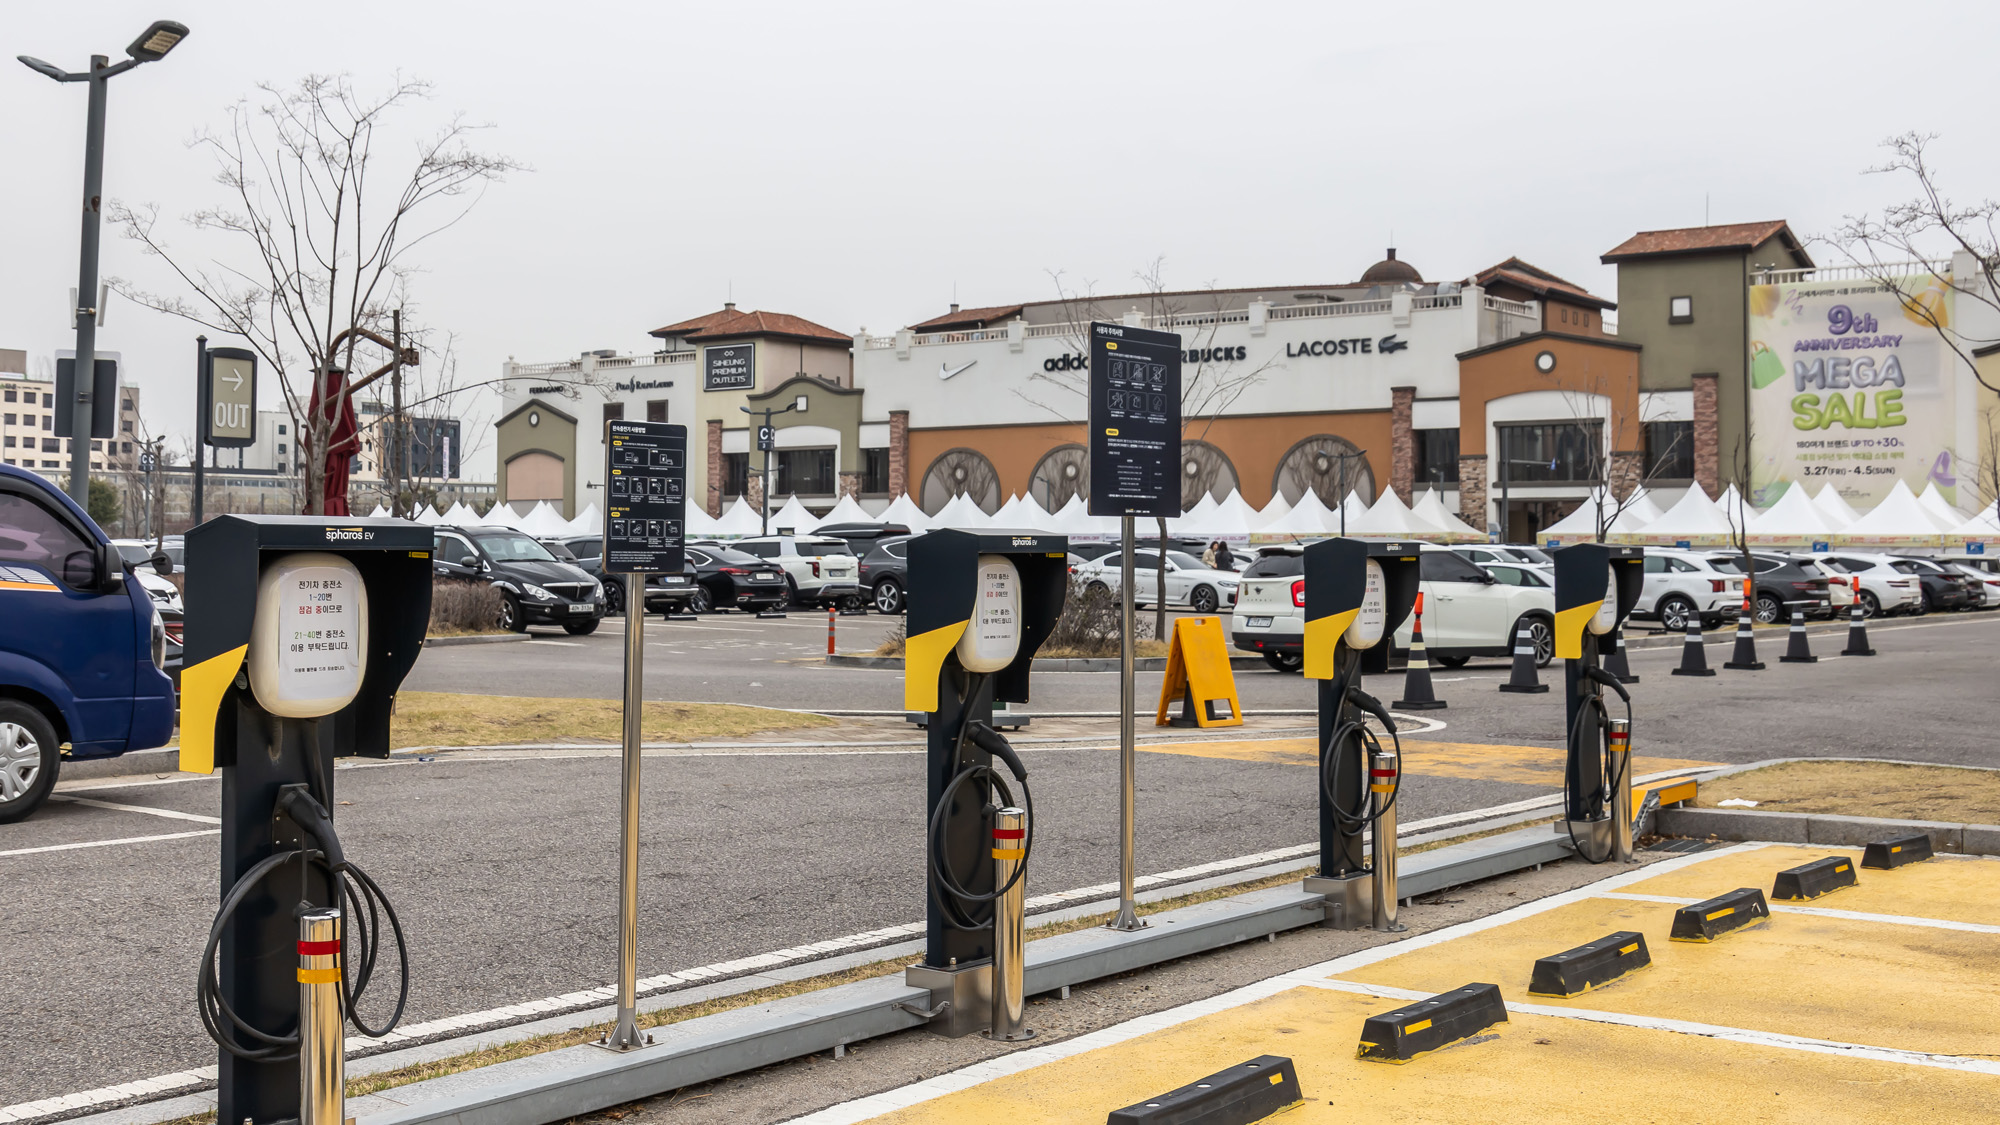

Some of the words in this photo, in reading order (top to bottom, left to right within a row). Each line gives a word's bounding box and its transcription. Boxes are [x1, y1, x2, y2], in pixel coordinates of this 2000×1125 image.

[1828, 304, 1877, 335] 9th
[1096, 326, 1107, 335] 사용자
[1287, 338, 1372, 357] LACOSTE
[1794, 335, 1902, 352] ANNIVERSARY
[712, 367, 746, 375] PREMIUM
[1793, 354, 1905, 392] MEGA
[712, 376, 746, 384] OUTLETS
[1791, 389, 1907, 431] SALE
[215, 402, 249, 428] OUT
[760, 428, 768, 440] C
[1827, 440, 1849, 448] 브랜드
[142, 454, 147, 464] C
[149, 455, 154, 464] C
[1804, 466, 1846, 475] 3.27(FRI)
[1854, 466, 1895, 475] 4.5(SUN)
[326, 529, 363, 542] spharos
[1012, 539, 1032, 547] spharos
[323, 581, 342, 589] 충전소
[309, 593, 332, 601] 1~20번
[299, 606, 312, 614] 점검
[316, 605, 342, 614] 중이므로
[295, 631, 322, 639] 21~40번
[326, 630, 345, 638] 충전소
[291, 644, 304, 652] 이용
[308, 642, 349, 651] 부탁드립니다.
